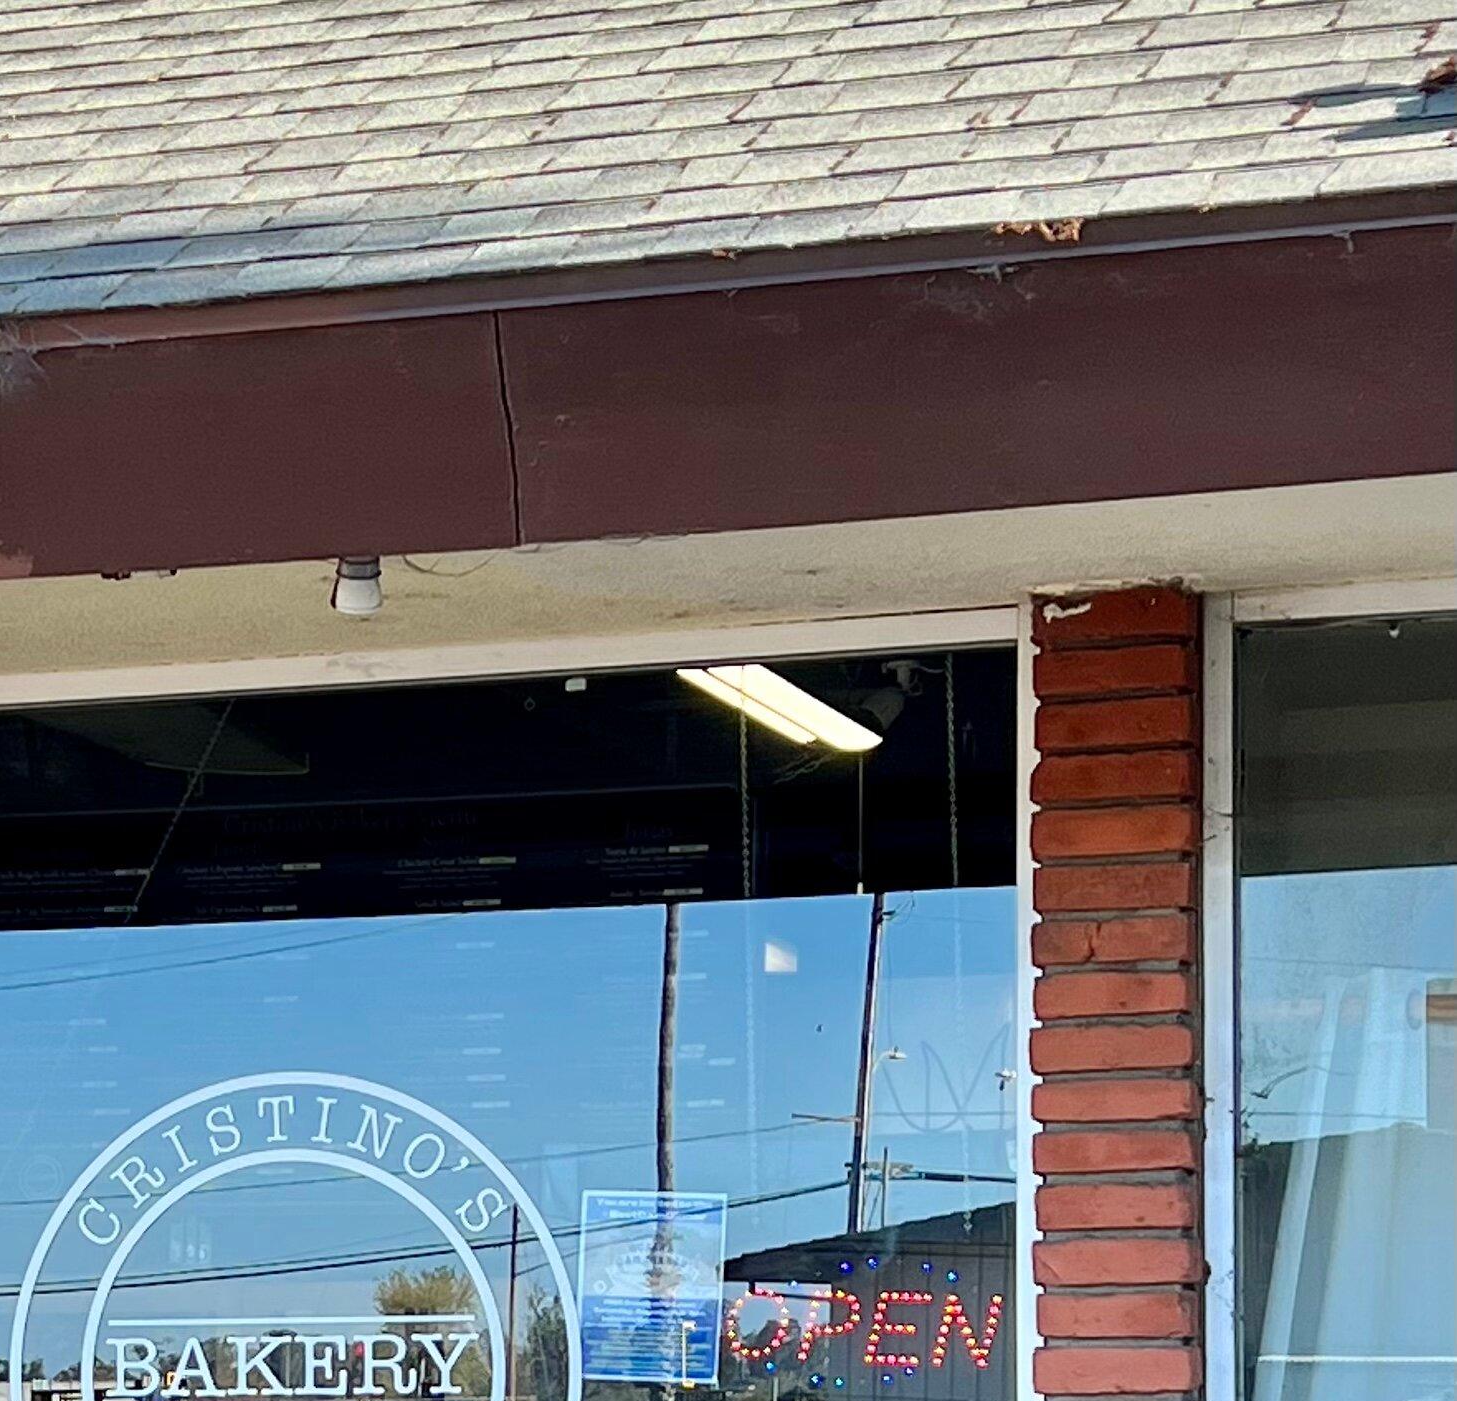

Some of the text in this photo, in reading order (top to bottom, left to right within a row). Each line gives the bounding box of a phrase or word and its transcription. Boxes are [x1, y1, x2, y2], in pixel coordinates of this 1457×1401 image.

[78, 1095, 511, 1246] CRISTINO'S
[106, 1332, 480, 1399] BAKERY
[726, 1287, 1004, 1368] OPEN
